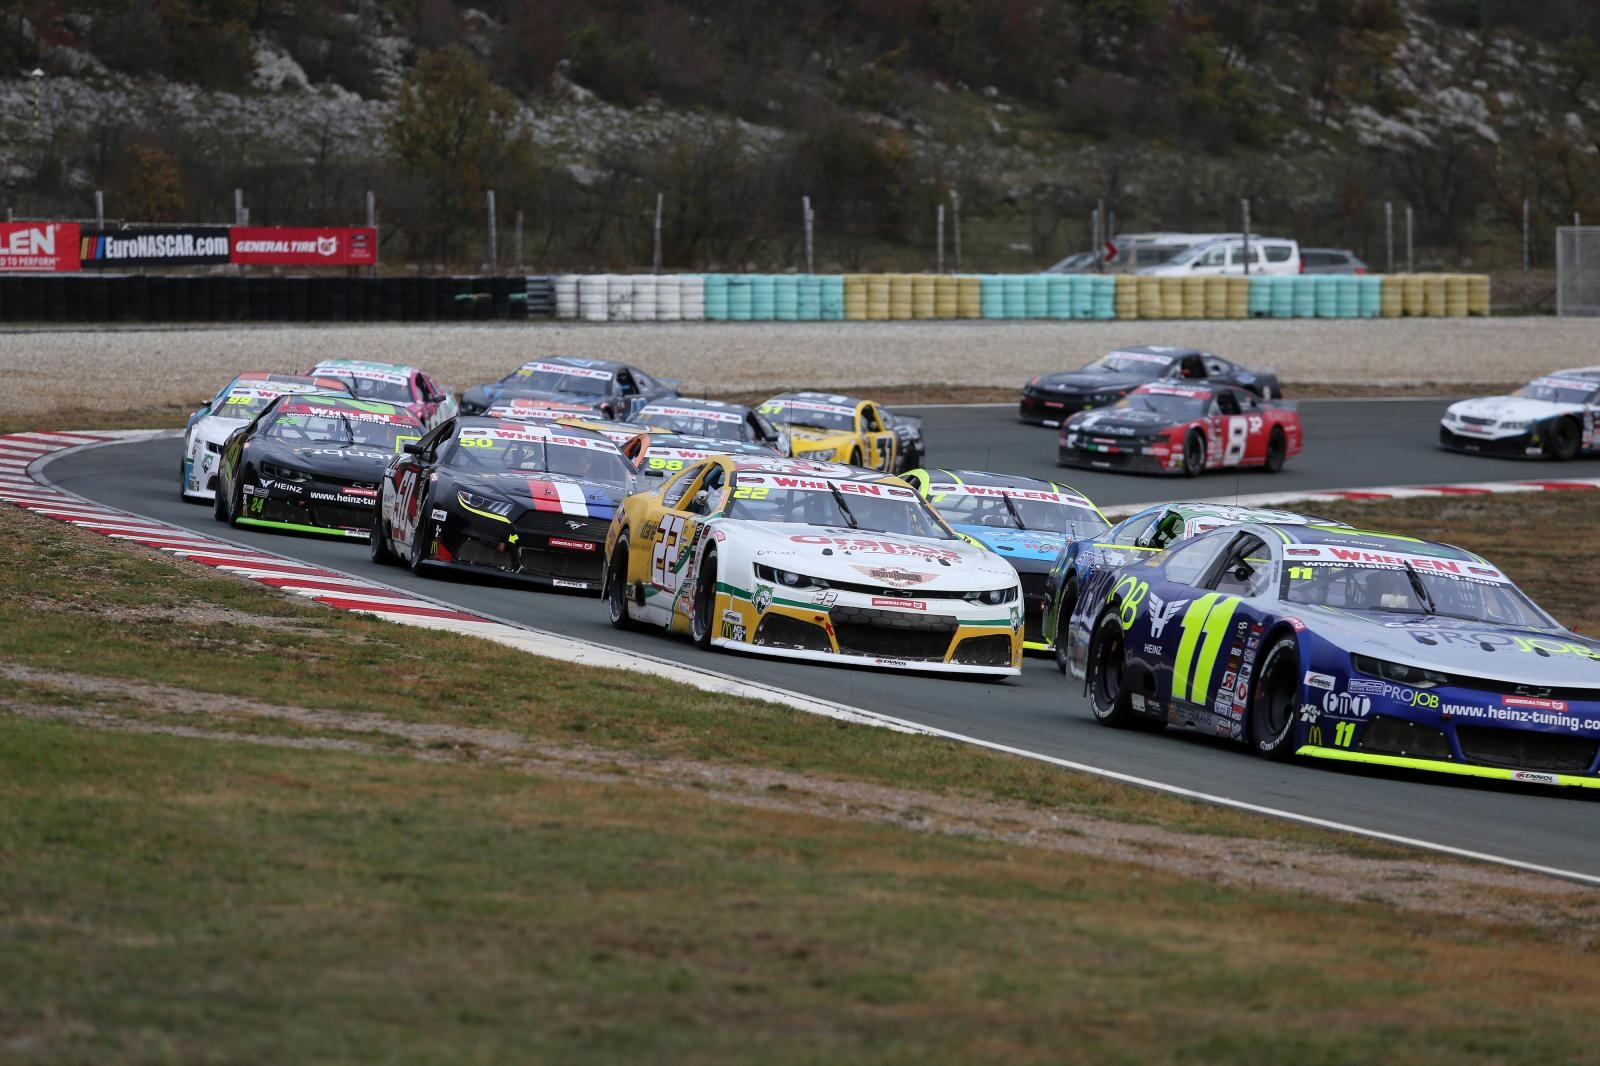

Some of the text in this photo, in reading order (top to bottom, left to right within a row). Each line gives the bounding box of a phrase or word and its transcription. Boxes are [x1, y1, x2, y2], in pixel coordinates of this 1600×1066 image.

[105, 235, 229, 260] EuroNASCAR.com
[236, 240, 317, 253] GENERAL TIRE
[308, 406, 390, 422] WHELEN
[512, 408, 576, 419] WHELEN
[459, 438, 493, 448] 50
[494, 430, 588, 447] WHELEN
[1223, 416, 1248, 465] 8
[649, 458, 684, 471] 98
[274, 482, 303, 493] HEINZ
[733, 486, 770, 499] 22
[963, 485, 1061, 502] WHELEN
[251, 497, 265, 512] 24
[652, 514, 686, 594] 22
[1328, 547, 1461, 575] WHELEN
[1288, 566, 1313, 580] 11
[812, 591, 838, 608] 22
[1144, 643, 1162, 656] HEINZ
[1171, 592, 1242, 706] 11
[1334, 721, 1356, 748] 11
[1517, 772, 1554, 782] KENNOL
